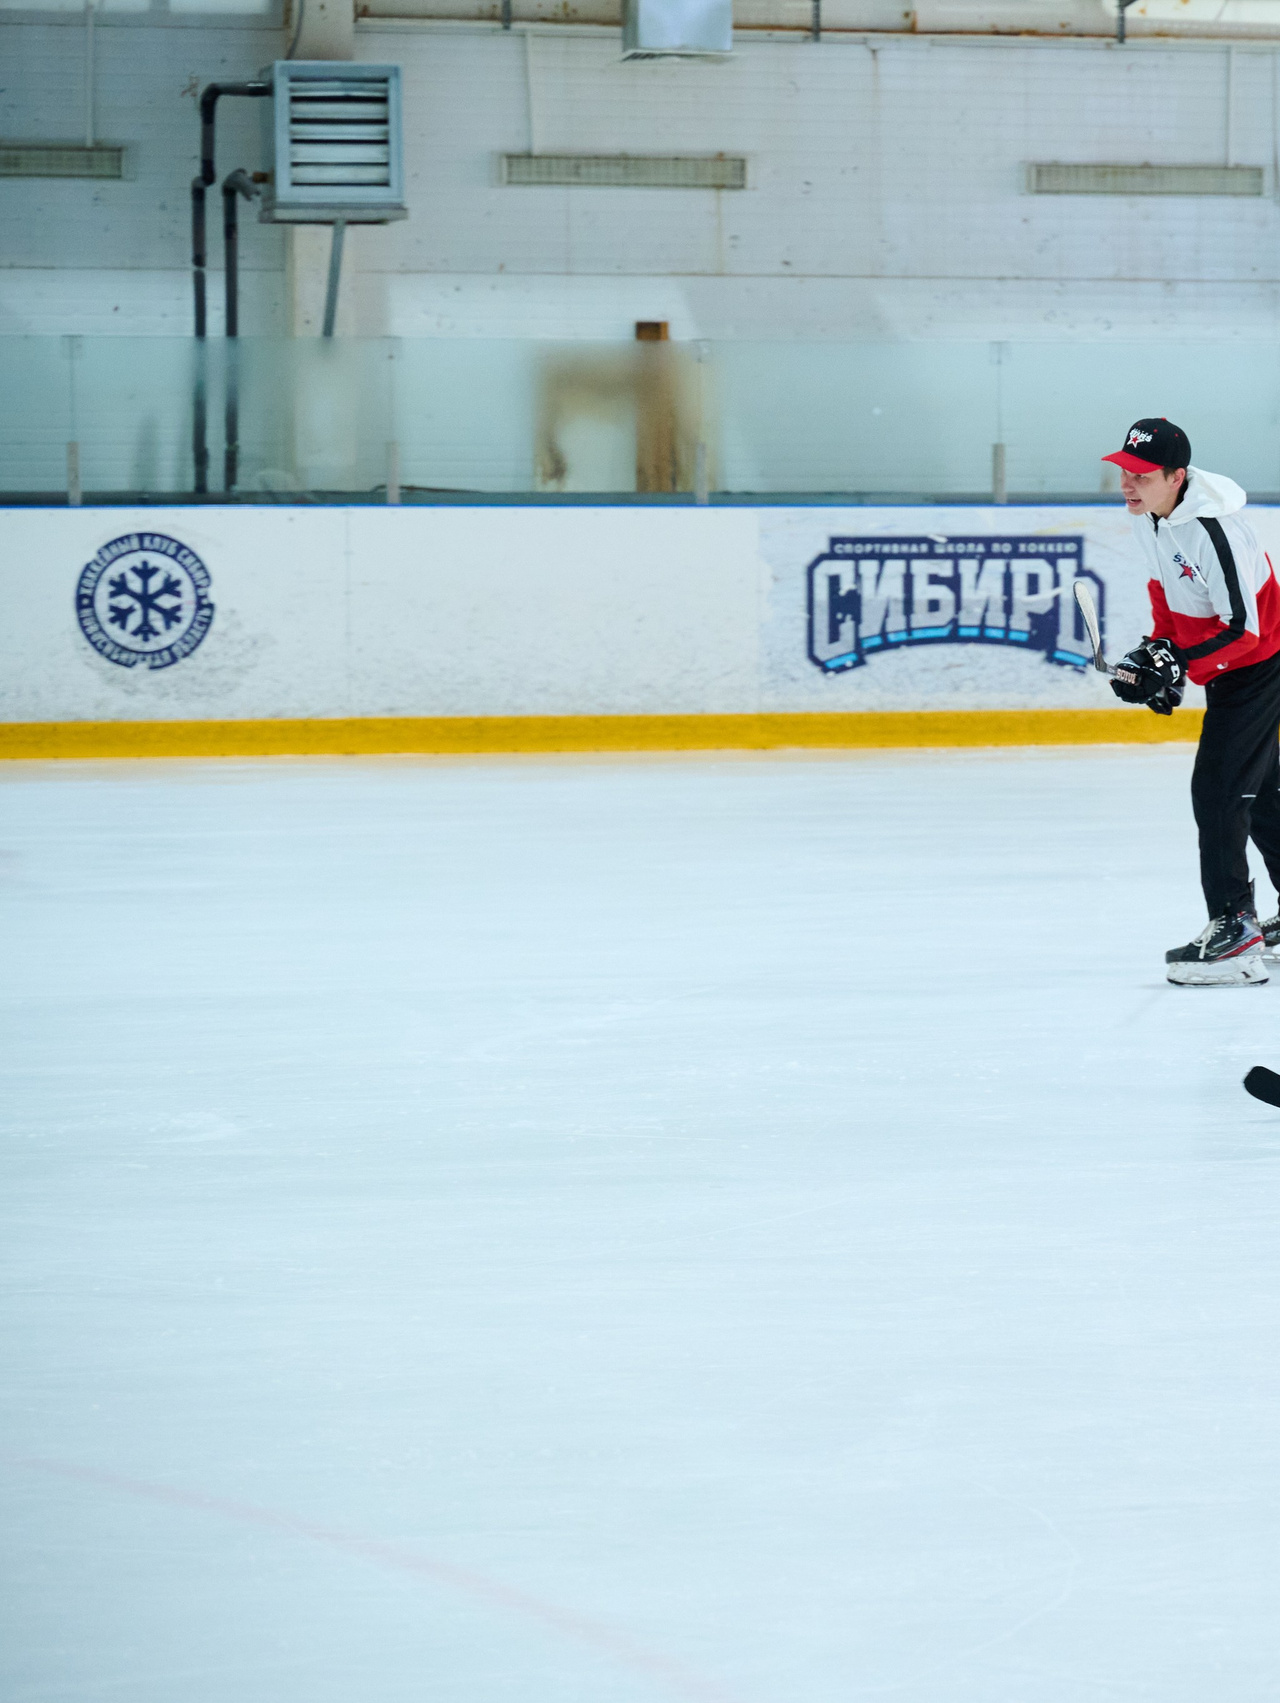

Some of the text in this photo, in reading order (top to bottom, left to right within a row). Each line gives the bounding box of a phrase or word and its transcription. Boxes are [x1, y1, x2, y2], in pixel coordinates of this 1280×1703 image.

[833, 543, 929, 554] СПОРТИВНАЯ
[934, 543, 985, 554] ШКОЛА
[991, 543, 1012, 554] ПО
[812, 559, 1099, 662] СИБИРЬ
